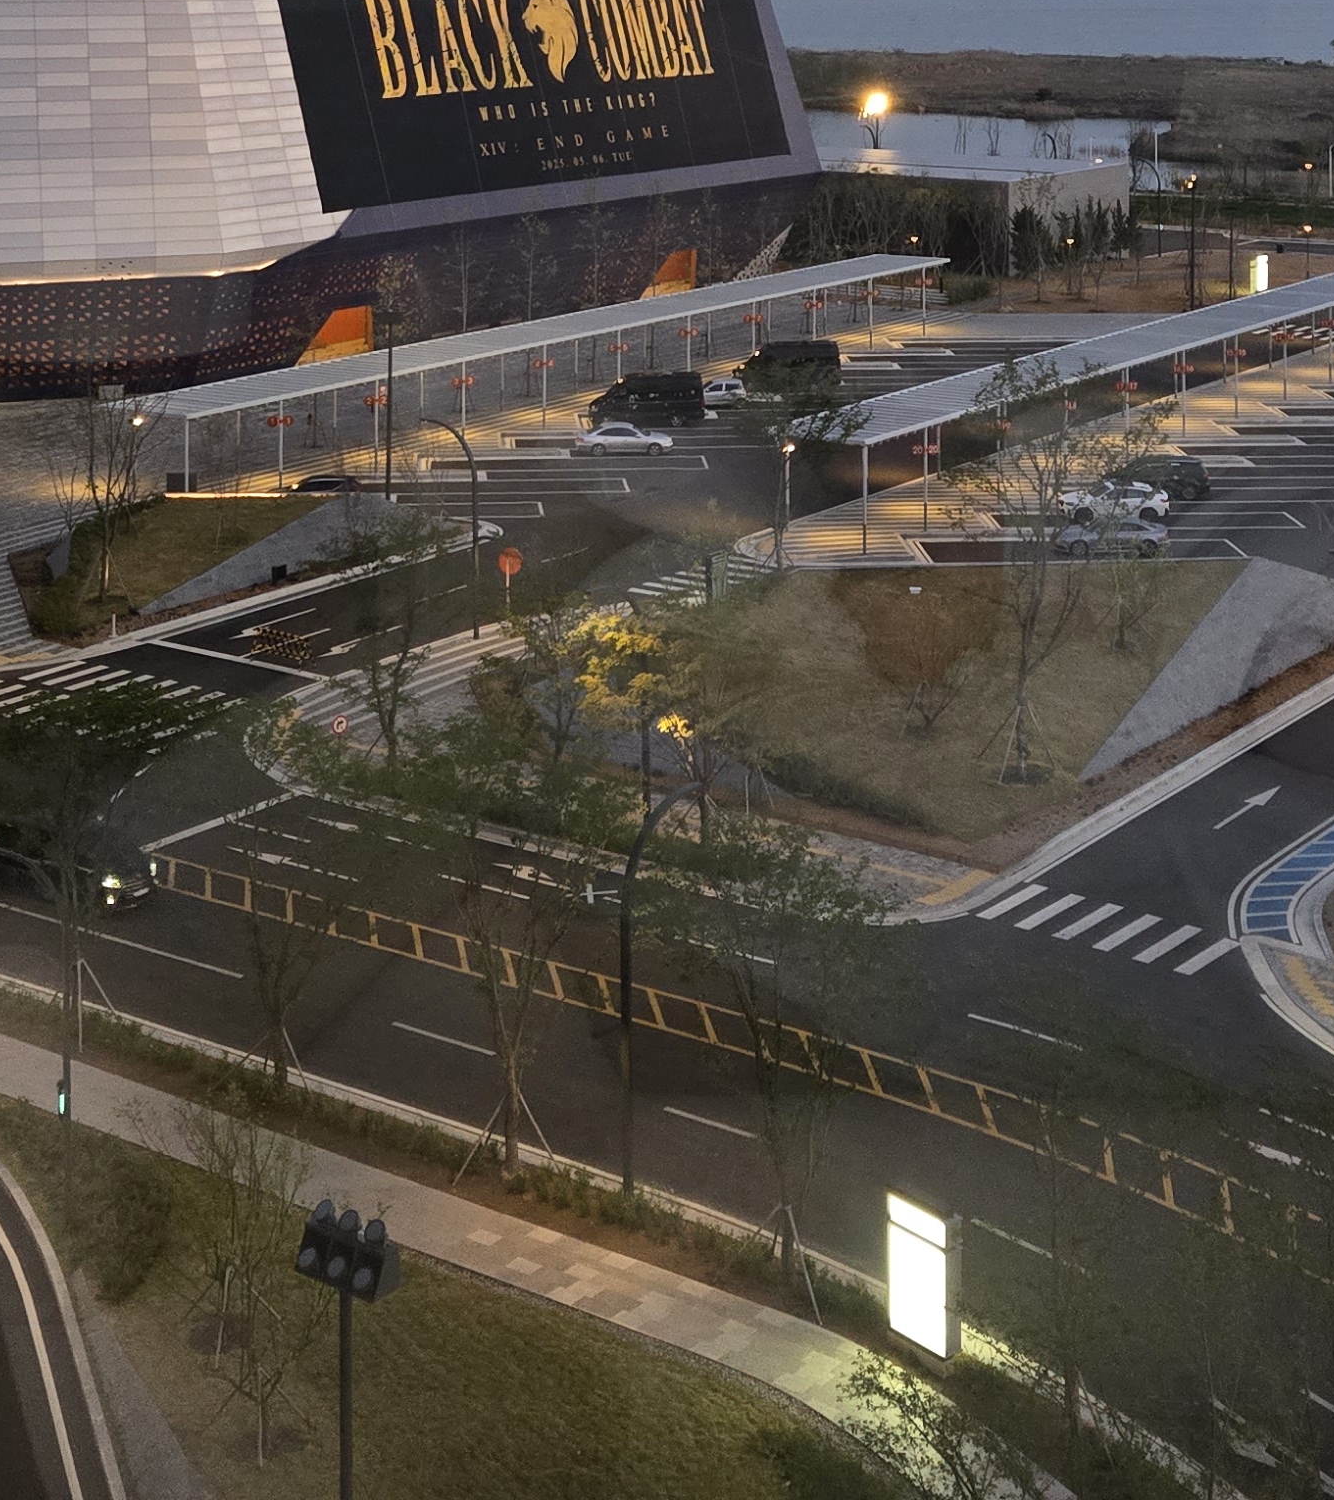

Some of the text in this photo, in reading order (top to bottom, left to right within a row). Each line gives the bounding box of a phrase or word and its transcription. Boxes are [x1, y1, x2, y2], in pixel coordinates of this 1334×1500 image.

[479, 92, 656, 122] WHO IS THE KING?
[536, 132, 584, 151] END
[606, 124, 670, 144] GAME
[612, 151, 633, 163] TUE
